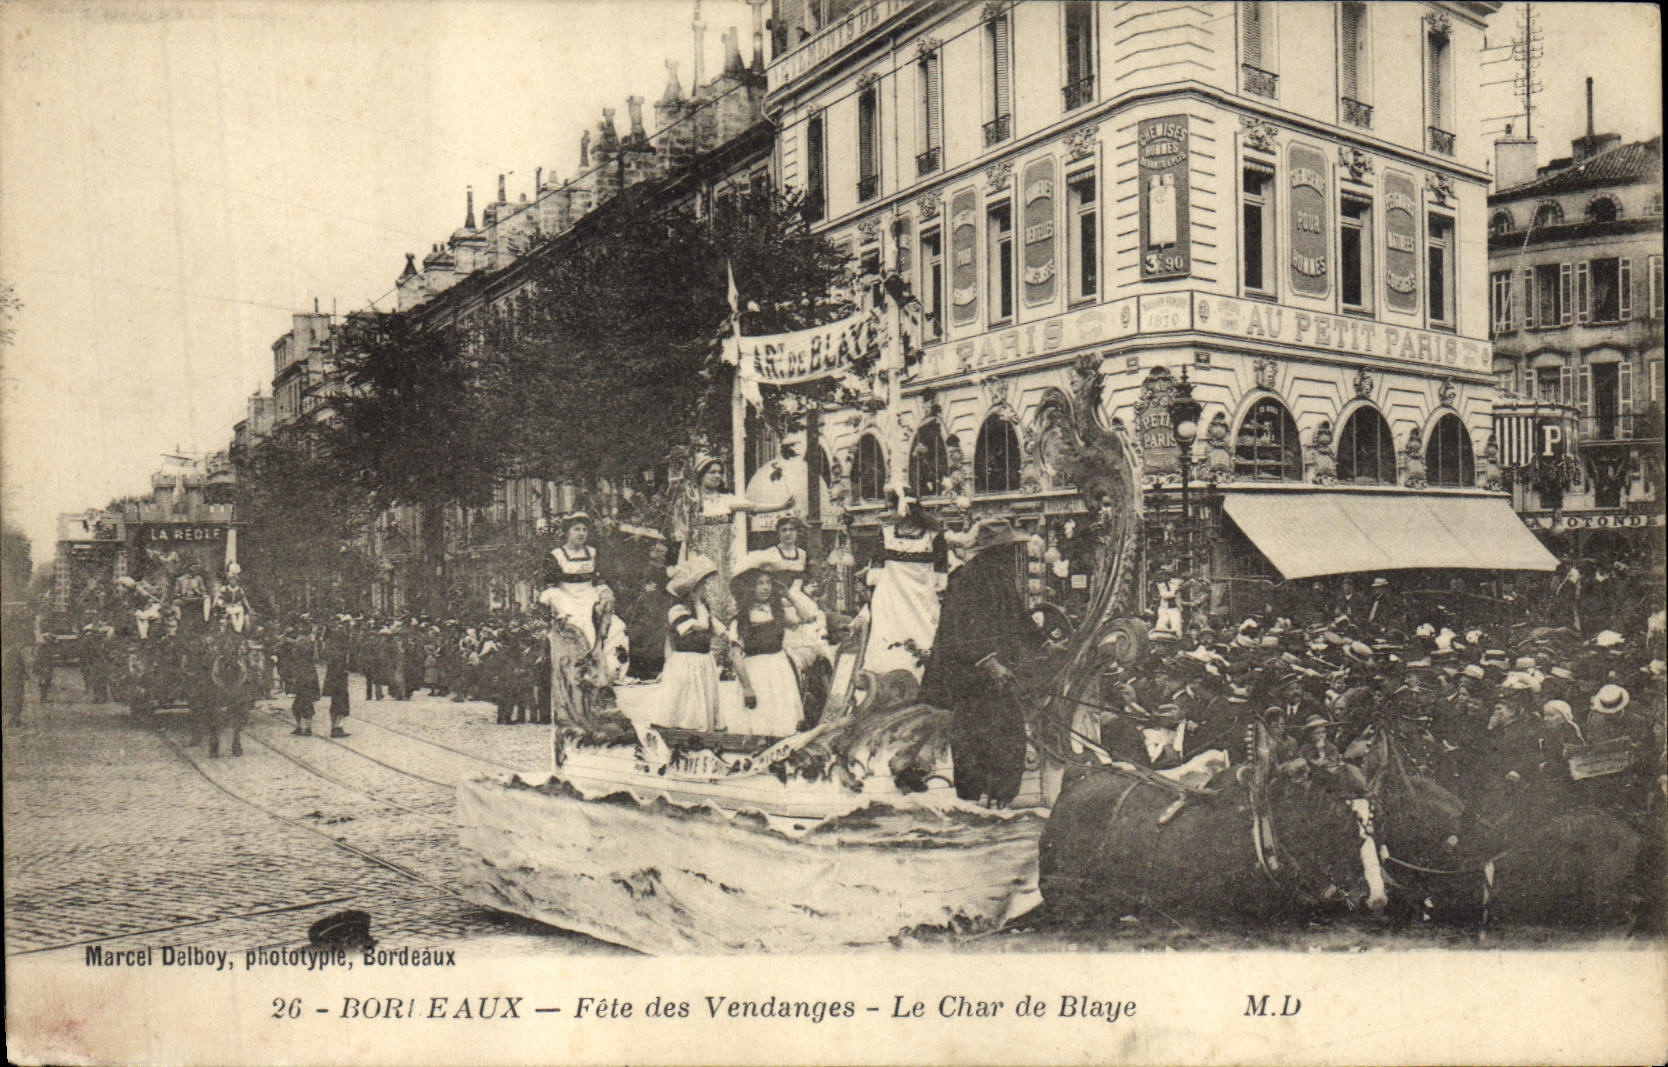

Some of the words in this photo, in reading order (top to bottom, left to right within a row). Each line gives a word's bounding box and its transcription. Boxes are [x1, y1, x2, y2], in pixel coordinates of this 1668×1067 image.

[1139, 122, 1188, 147] CHEMISES
[1297, 210, 1320, 235] POUR
[1165, 256, 1184, 271] 90
[1148, 303, 1179, 327] 1870
[810, 321, 878, 373] BLAYE
[956, 321, 1063, 371] PARIS
[1246, 304, 1283, 338] AU
[1294, 311, 1377, 353] PETIT
[1384, 327, 1458, 365] PARIS
[1143, 432, 1177, 449] PARIS
[151, 528, 168, 541] LA
